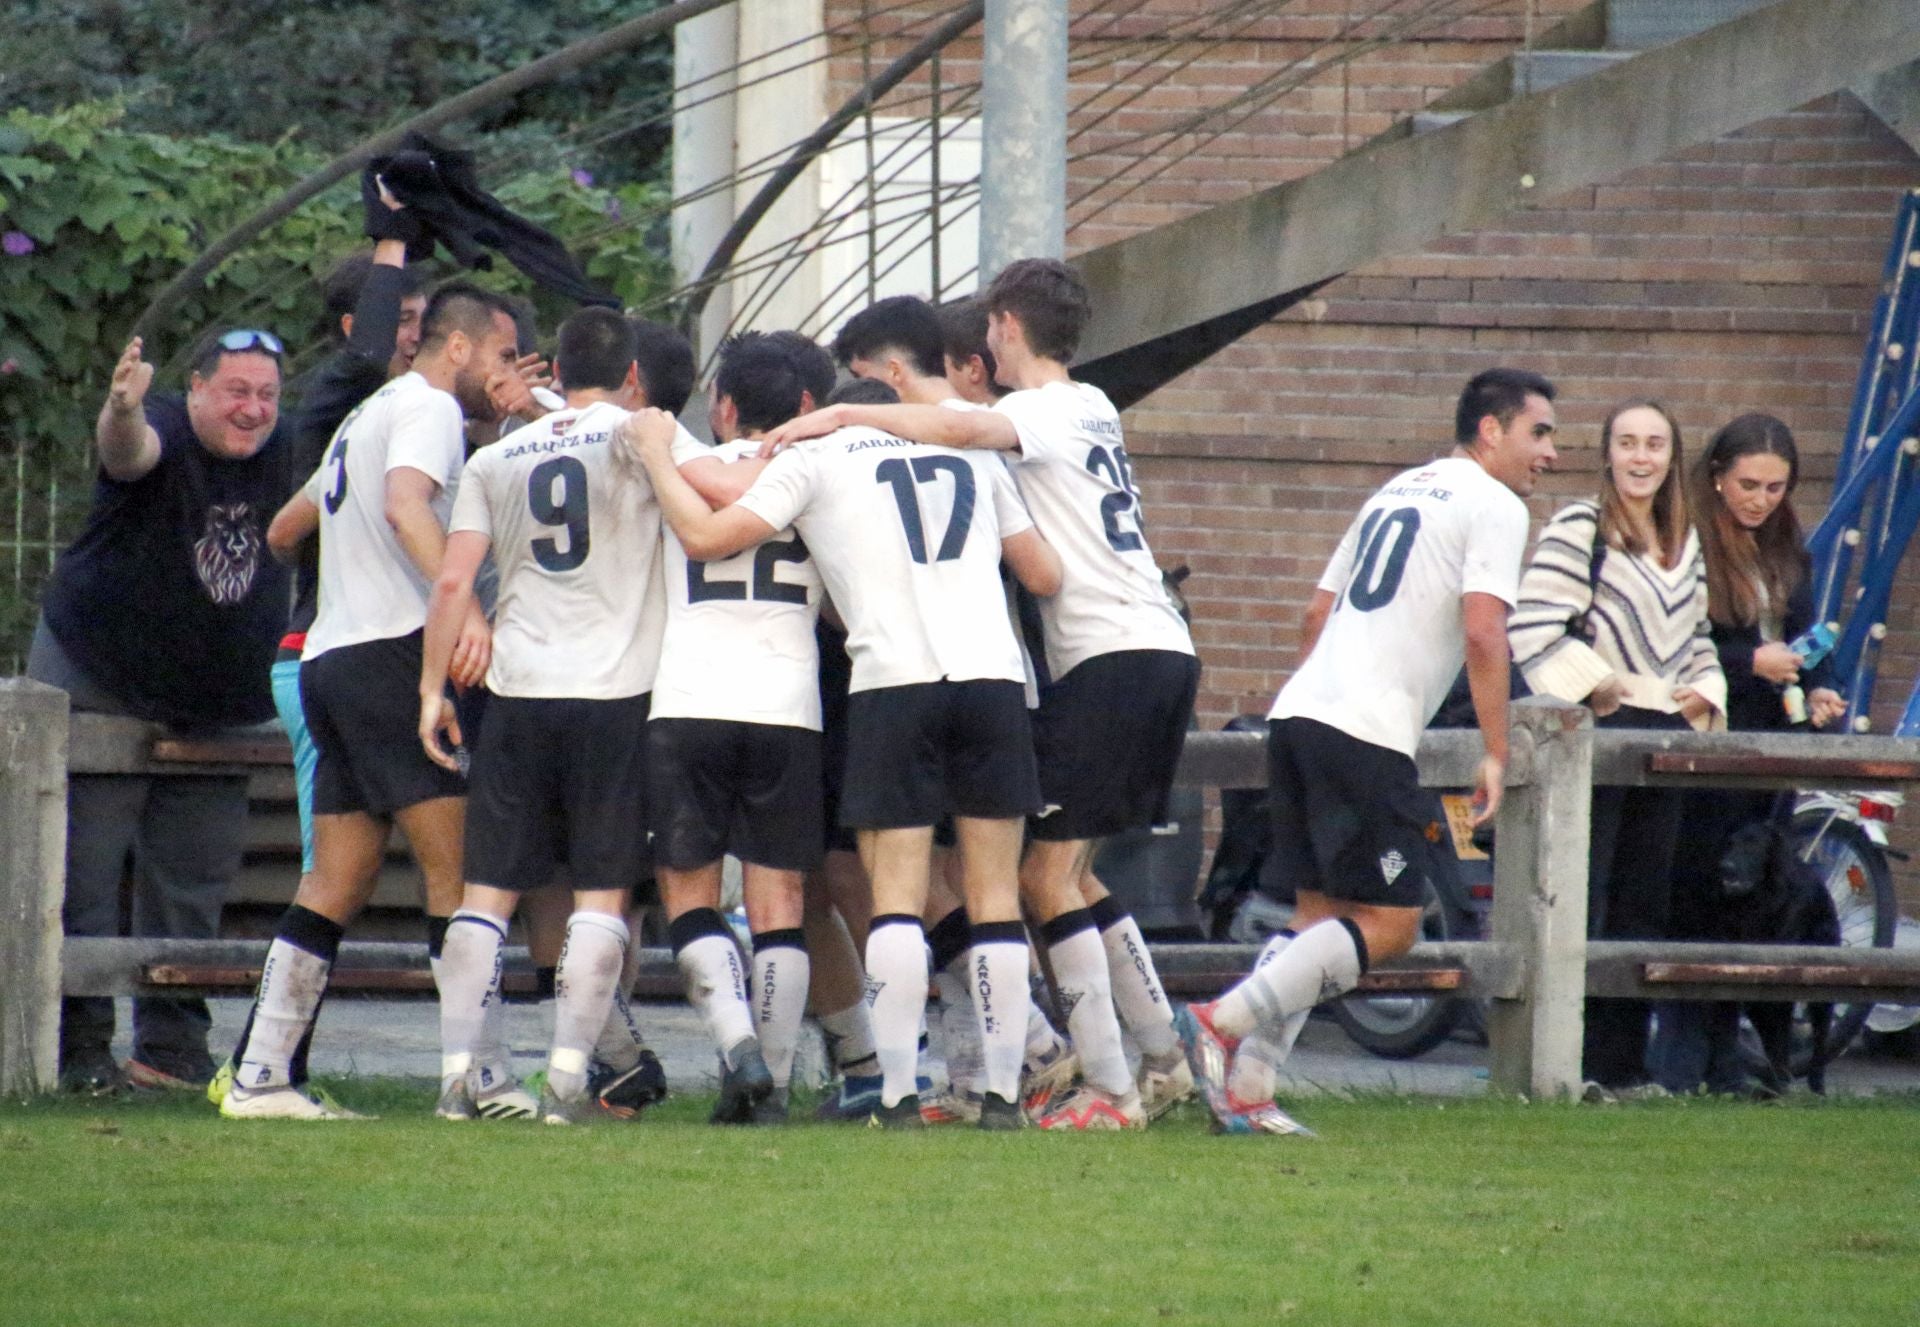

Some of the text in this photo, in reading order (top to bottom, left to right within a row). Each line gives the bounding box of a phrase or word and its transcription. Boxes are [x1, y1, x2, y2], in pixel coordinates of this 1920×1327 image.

[528, 455, 590, 572] 9
[876, 455, 976, 564] 17
[1334, 507, 1421, 613] 10
[977, 955, 992, 1012] ZARAUTZ
